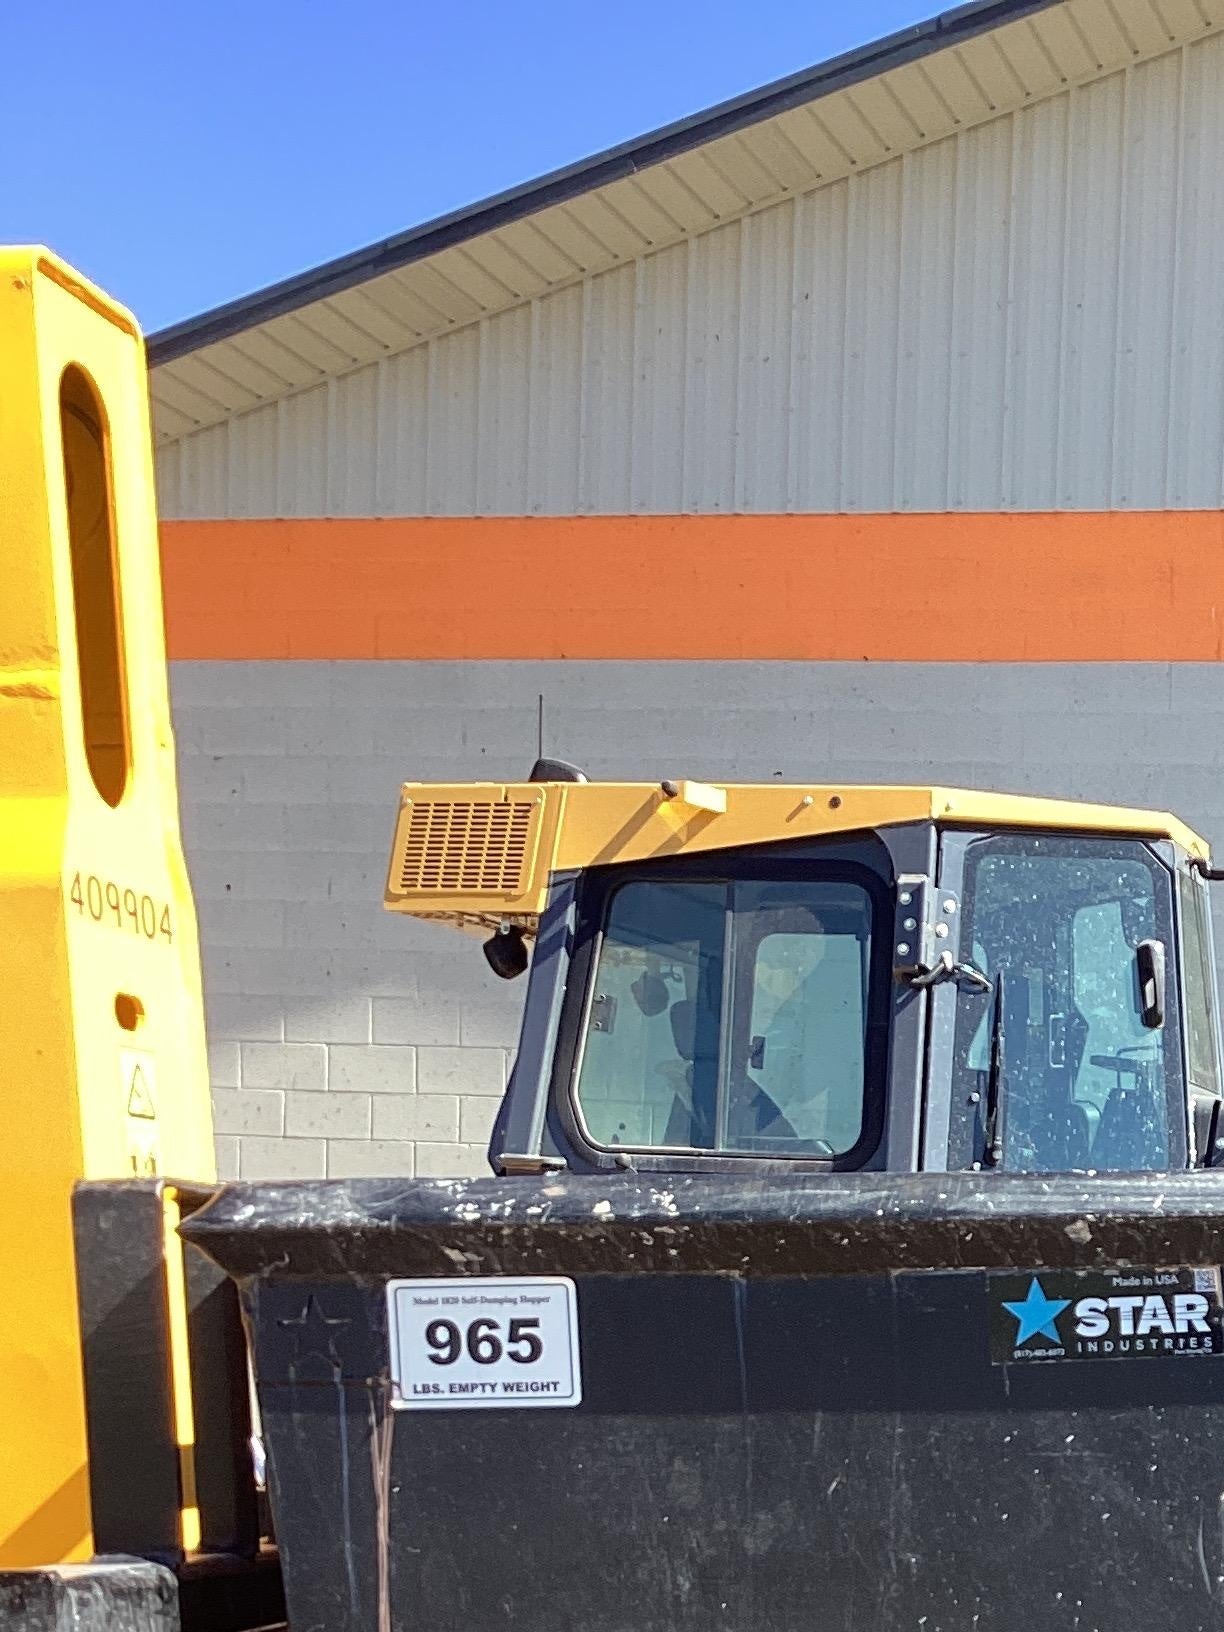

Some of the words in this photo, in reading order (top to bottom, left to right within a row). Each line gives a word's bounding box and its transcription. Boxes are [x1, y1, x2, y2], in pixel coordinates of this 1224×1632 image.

[71, 872, 172, 944] 409904
[1112, 1277, 1141, 1287] Made
[1143, 1276, 1153, 1285] in
[1156, 1275, 1179, 1284] USA
[1074, 1293, 1212, 1337] STAR
[425, 1317, 543, 1365] 965
[1078, 1337, 1213, 1353] INDUSTRIES
[413, 1383, 445, 1395] LBS.
[449, 1382, 497, 1394] EMPTY
[502, 1381, 560, 1393] WEIGHT
